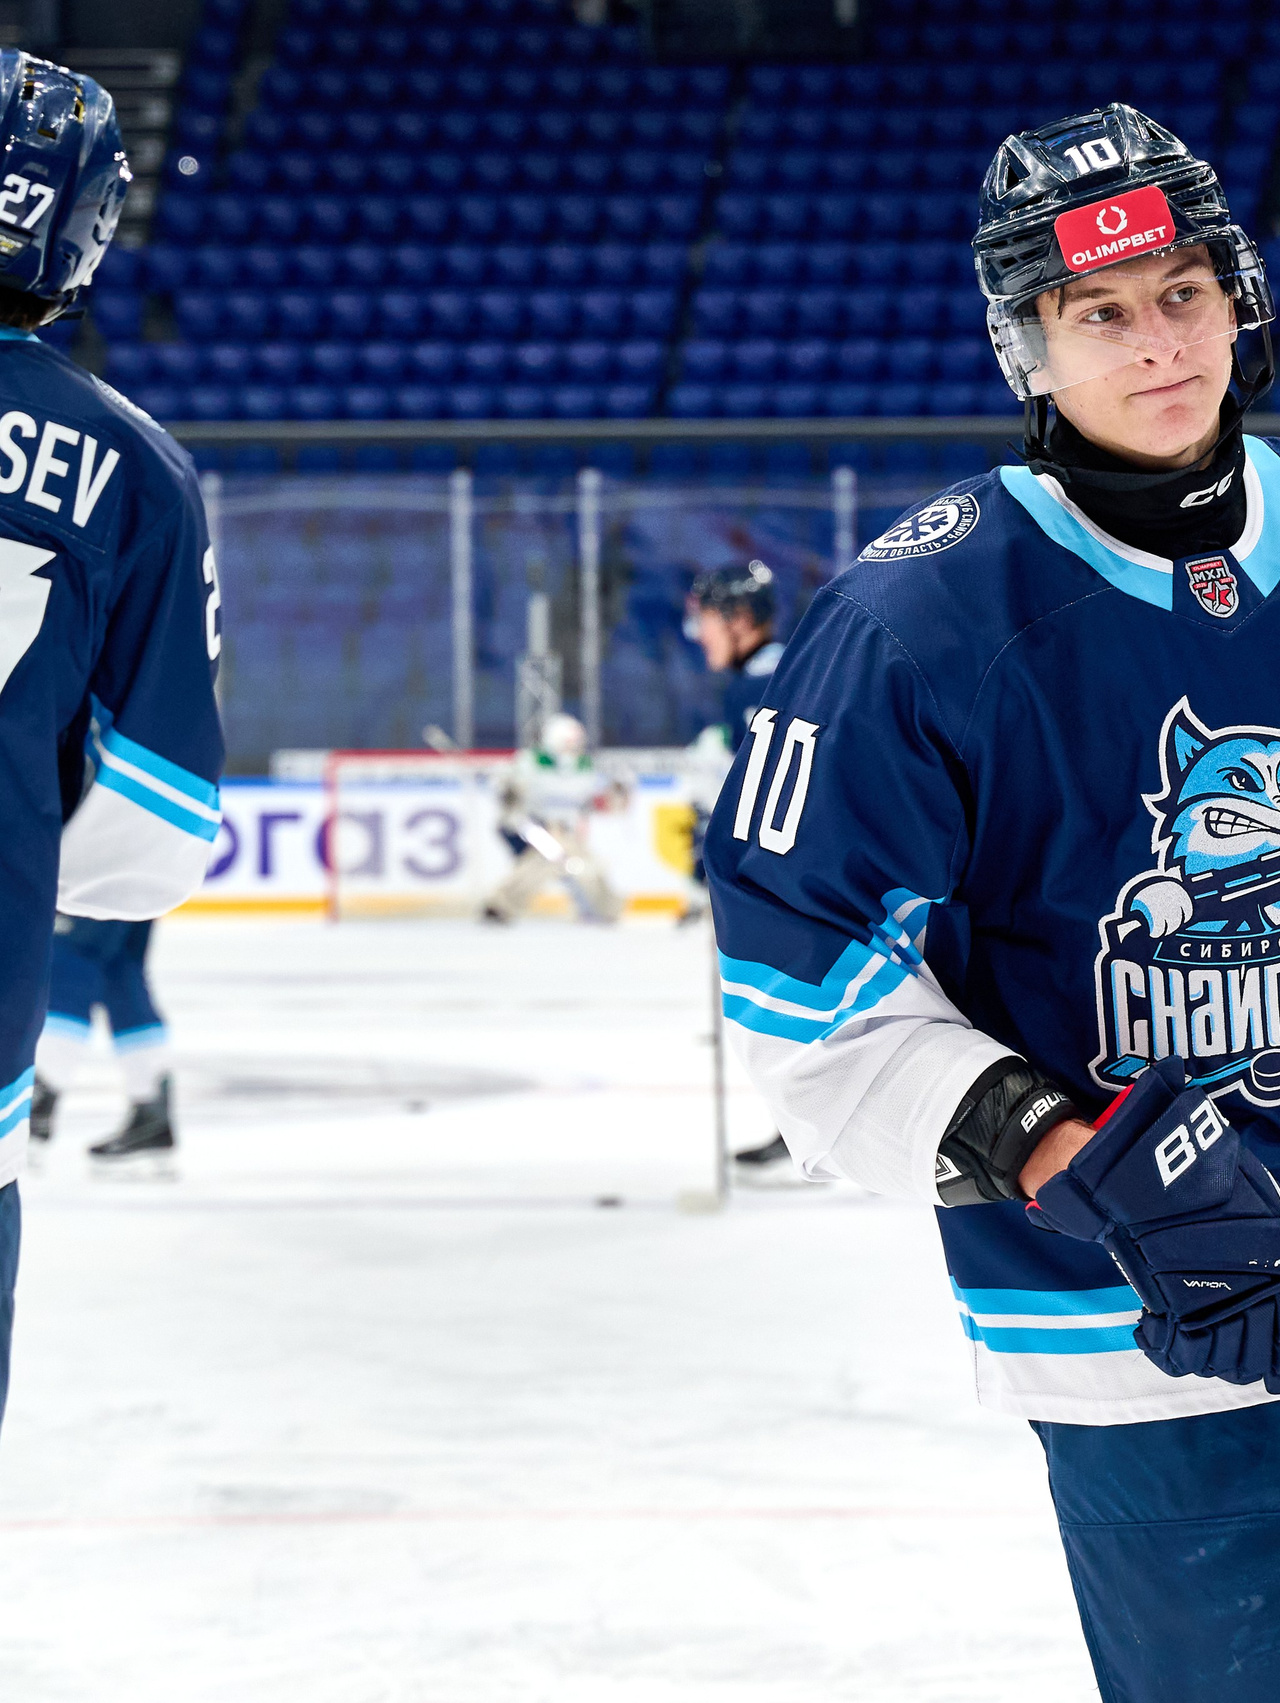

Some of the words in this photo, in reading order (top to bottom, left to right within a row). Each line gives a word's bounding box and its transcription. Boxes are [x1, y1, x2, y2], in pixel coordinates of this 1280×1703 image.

[1063, 136, 1123, 175] 10
[0, 173, 56, 229] 27
[1071, 225, 1166, 265] OLIMPBET
[946, 513, 975, 539] СИБИРЬ
[889, 541, 942, 557] ОБЛАСТЬ
[1192, 567, 1227, 582] МХЛ
[732, 707, 820, 855] 10
[1154, 1094, 1230, 1189] Ba
